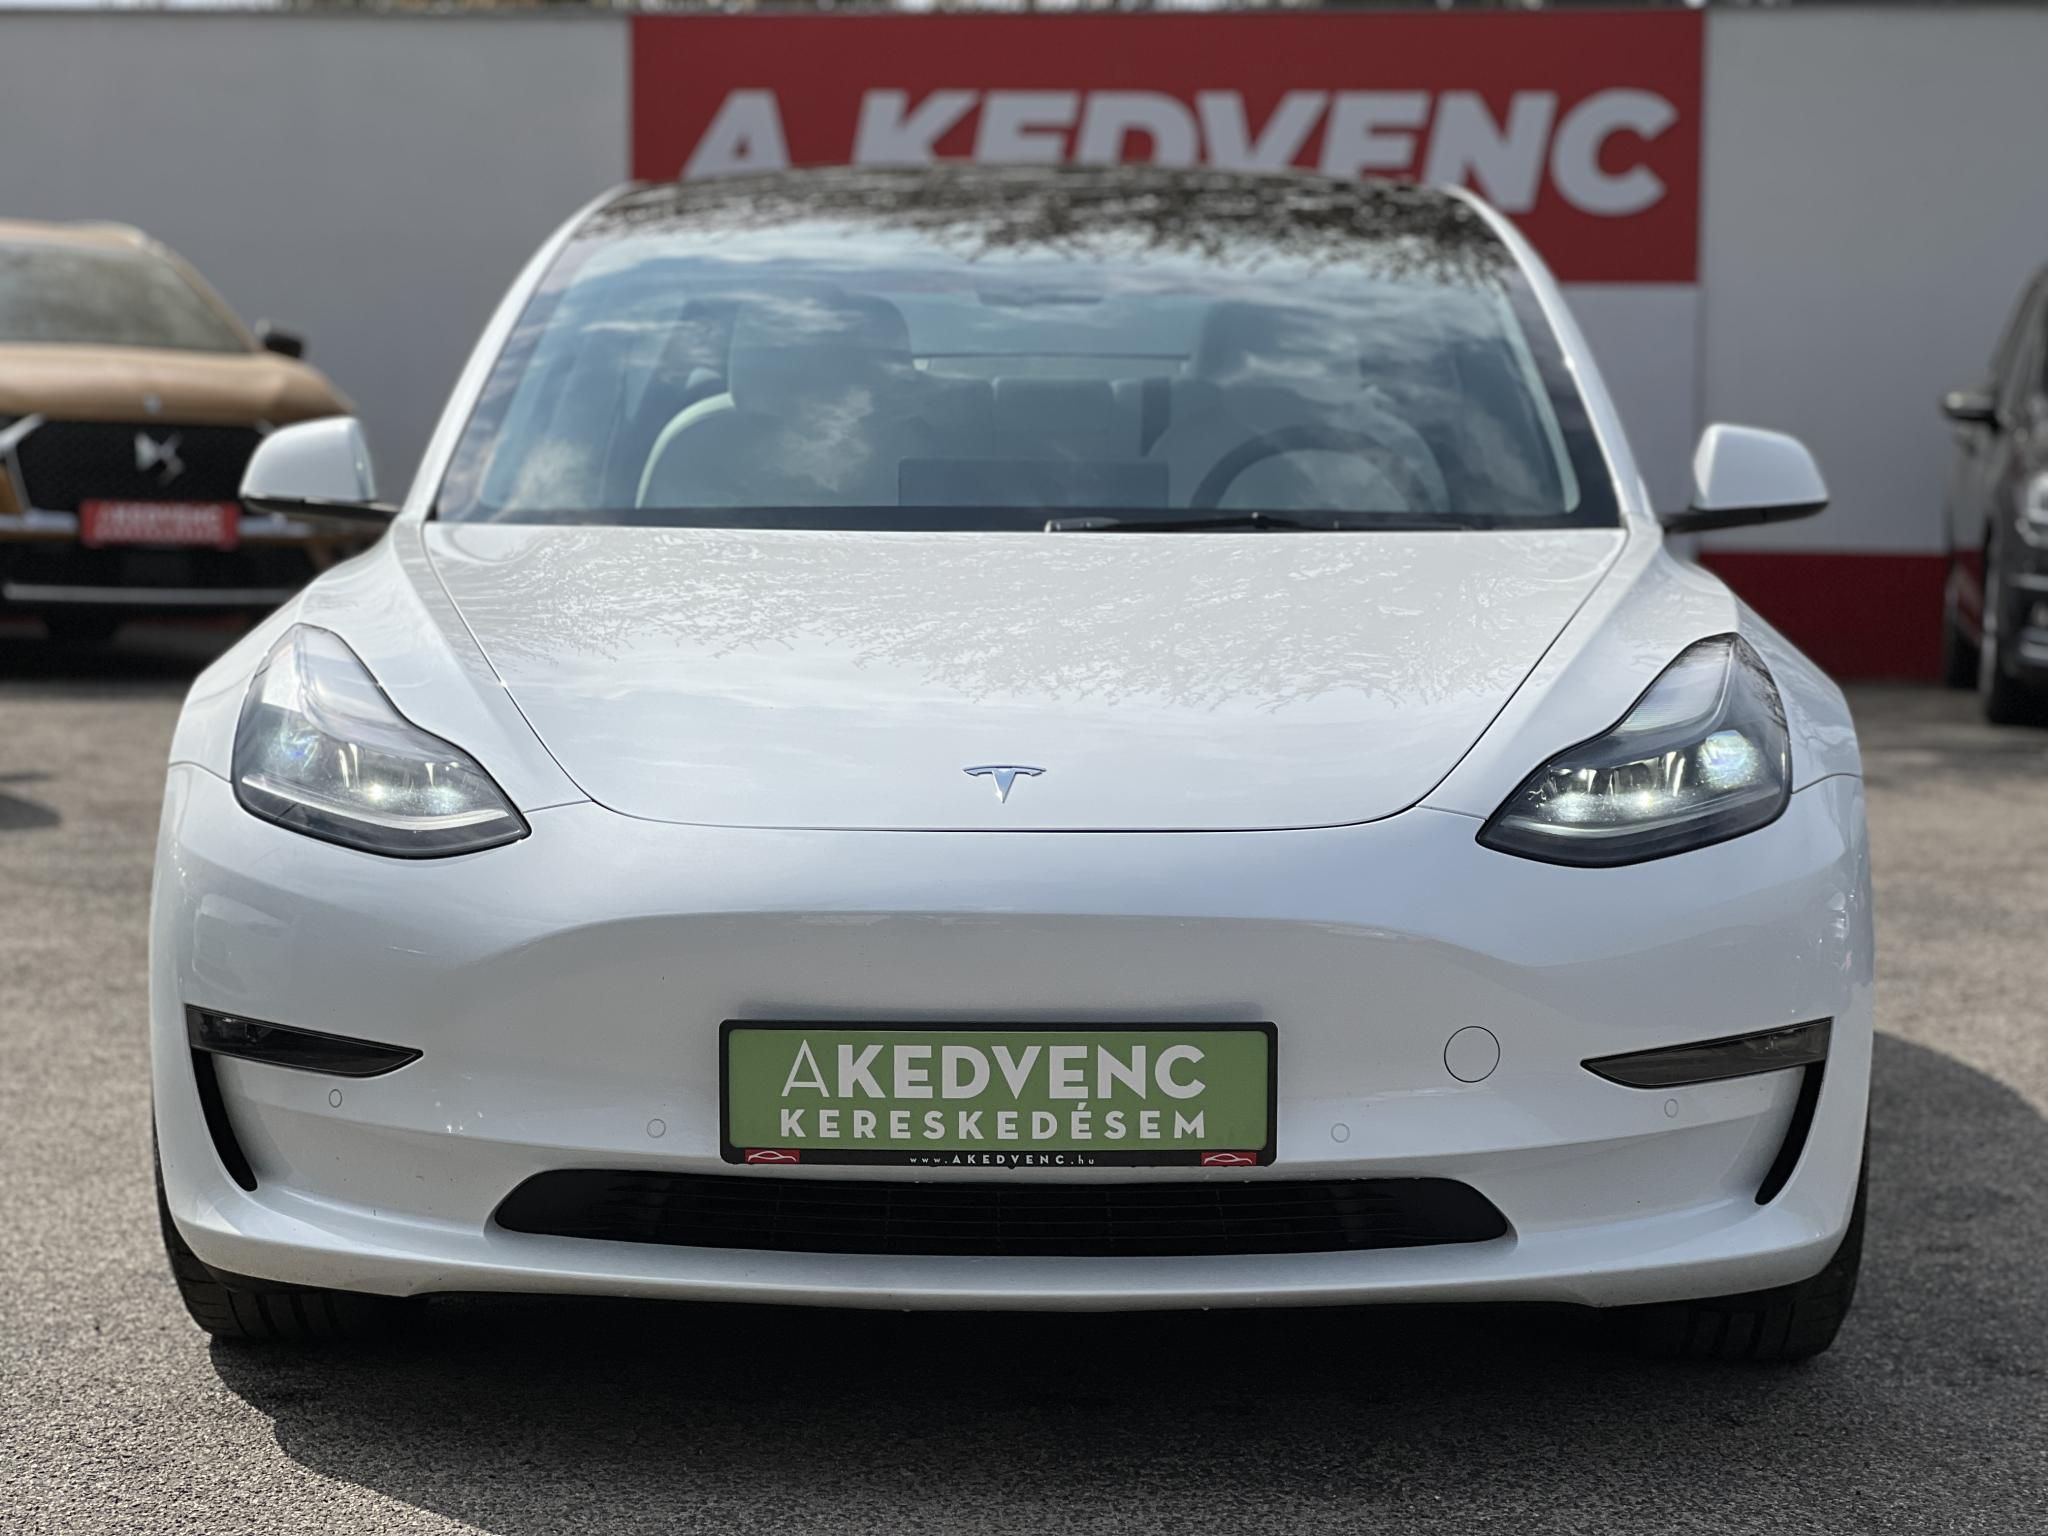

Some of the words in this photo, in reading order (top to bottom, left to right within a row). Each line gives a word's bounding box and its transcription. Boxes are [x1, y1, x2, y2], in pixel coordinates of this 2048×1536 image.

[679, 90, 790, 182] A
[848, 89, 1679, 216] KEDVENC
[780, 1102, 1206, 1140] KERESKEDÉSEM
